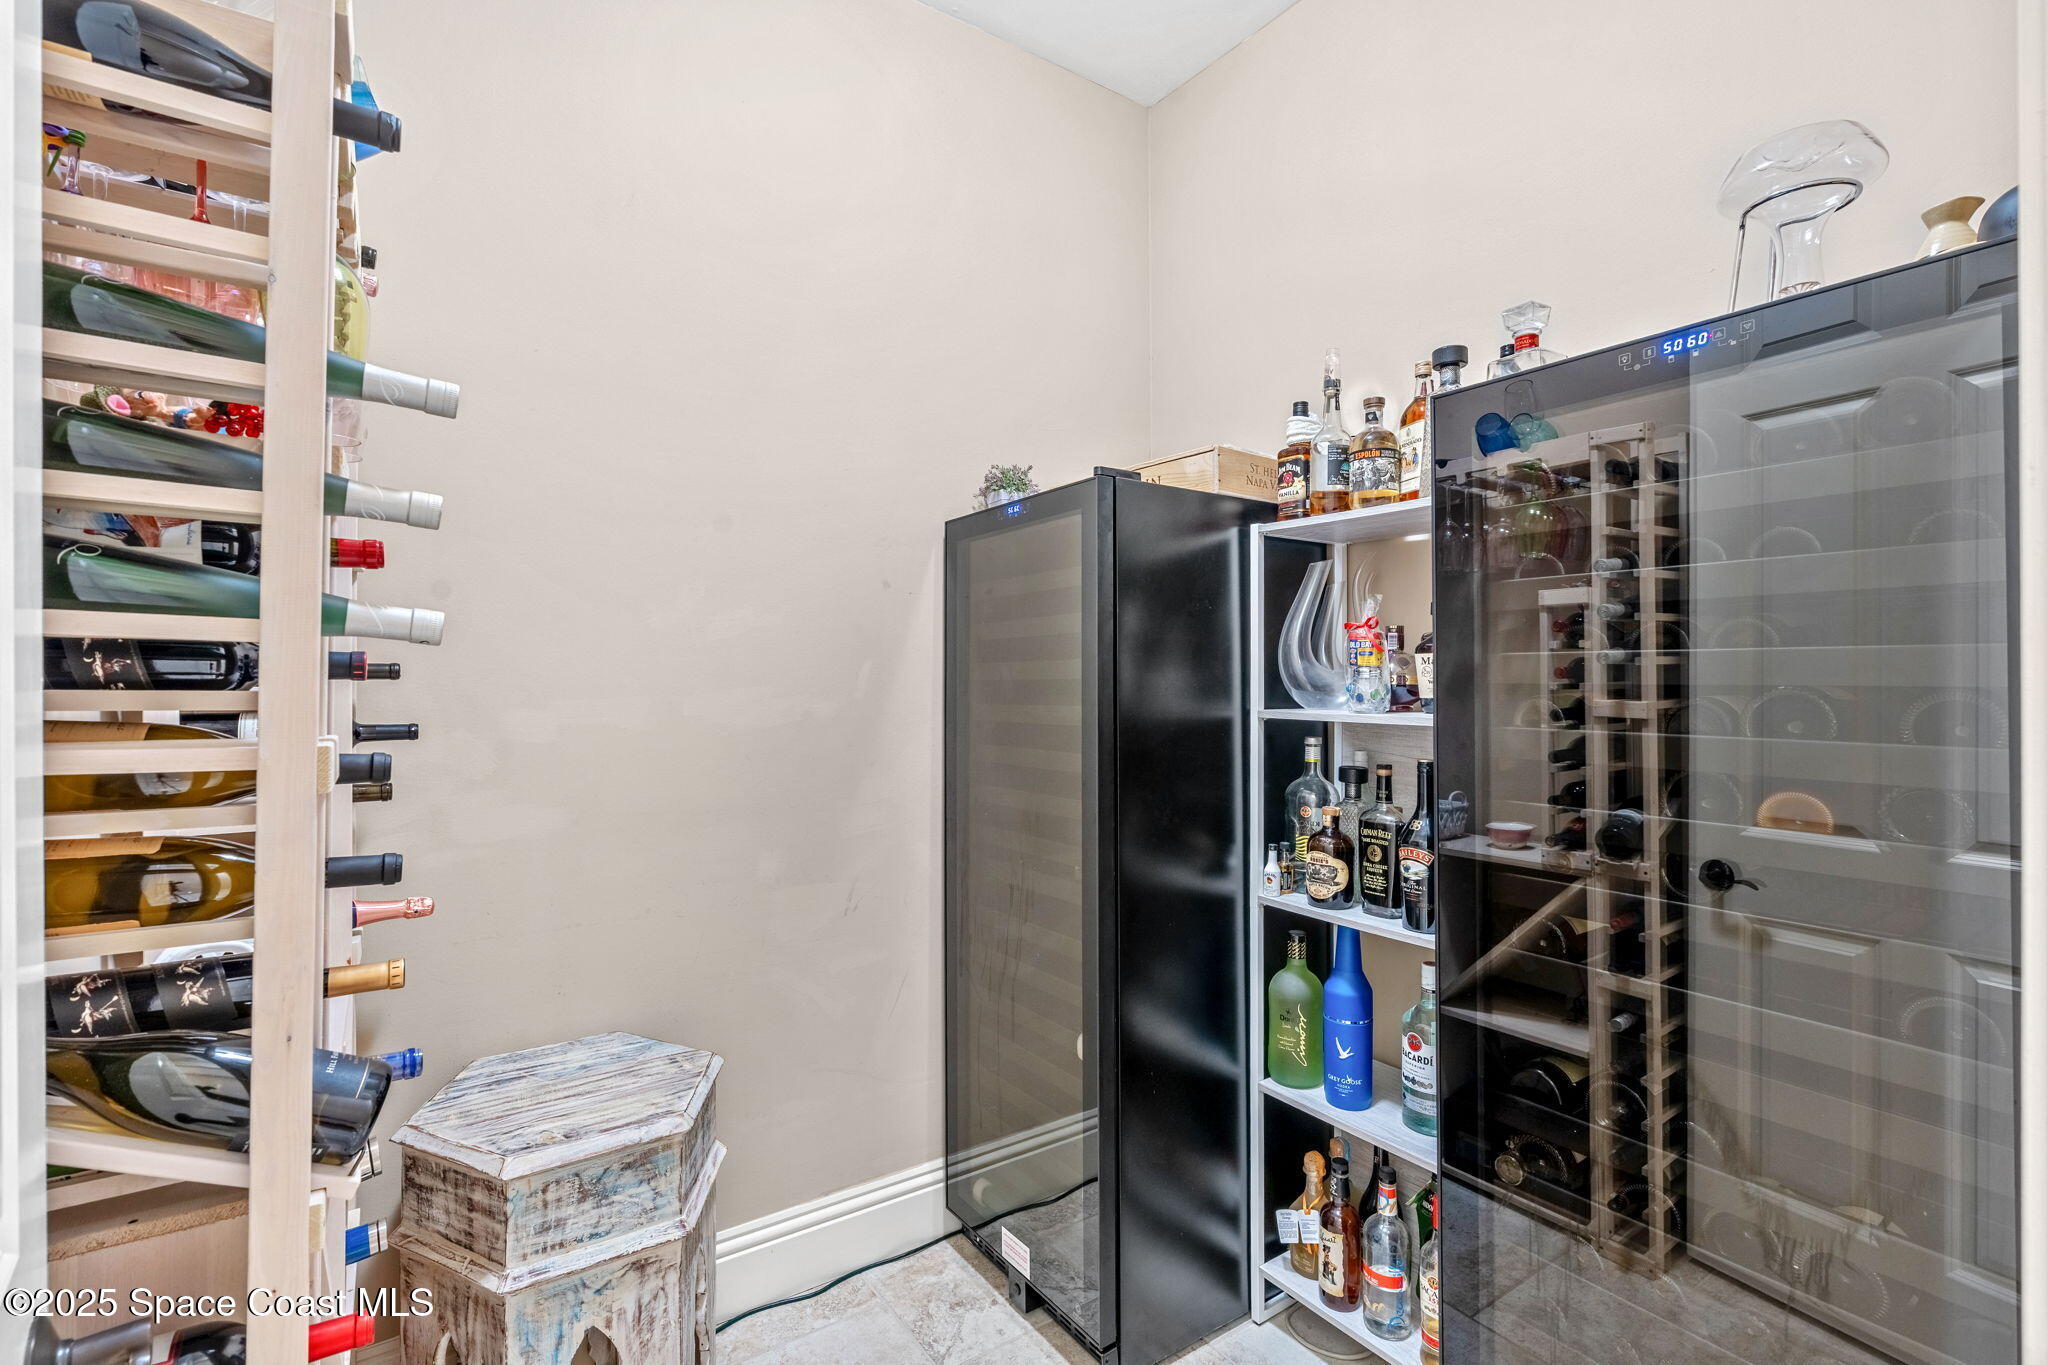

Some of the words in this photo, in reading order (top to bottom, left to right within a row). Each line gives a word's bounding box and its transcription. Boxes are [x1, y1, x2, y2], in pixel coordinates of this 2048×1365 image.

[1663, 339, 1683, 355] 50
[1686, 331, 1708, 349] 60
[1355, 449, 1380, 460] ESPOLÓN
[1246, 474, 1269, 489] NAPA
[1279, 490, 1300, 498] VANILLA
[1341, 1078, 1363, 1086] GOOSE
